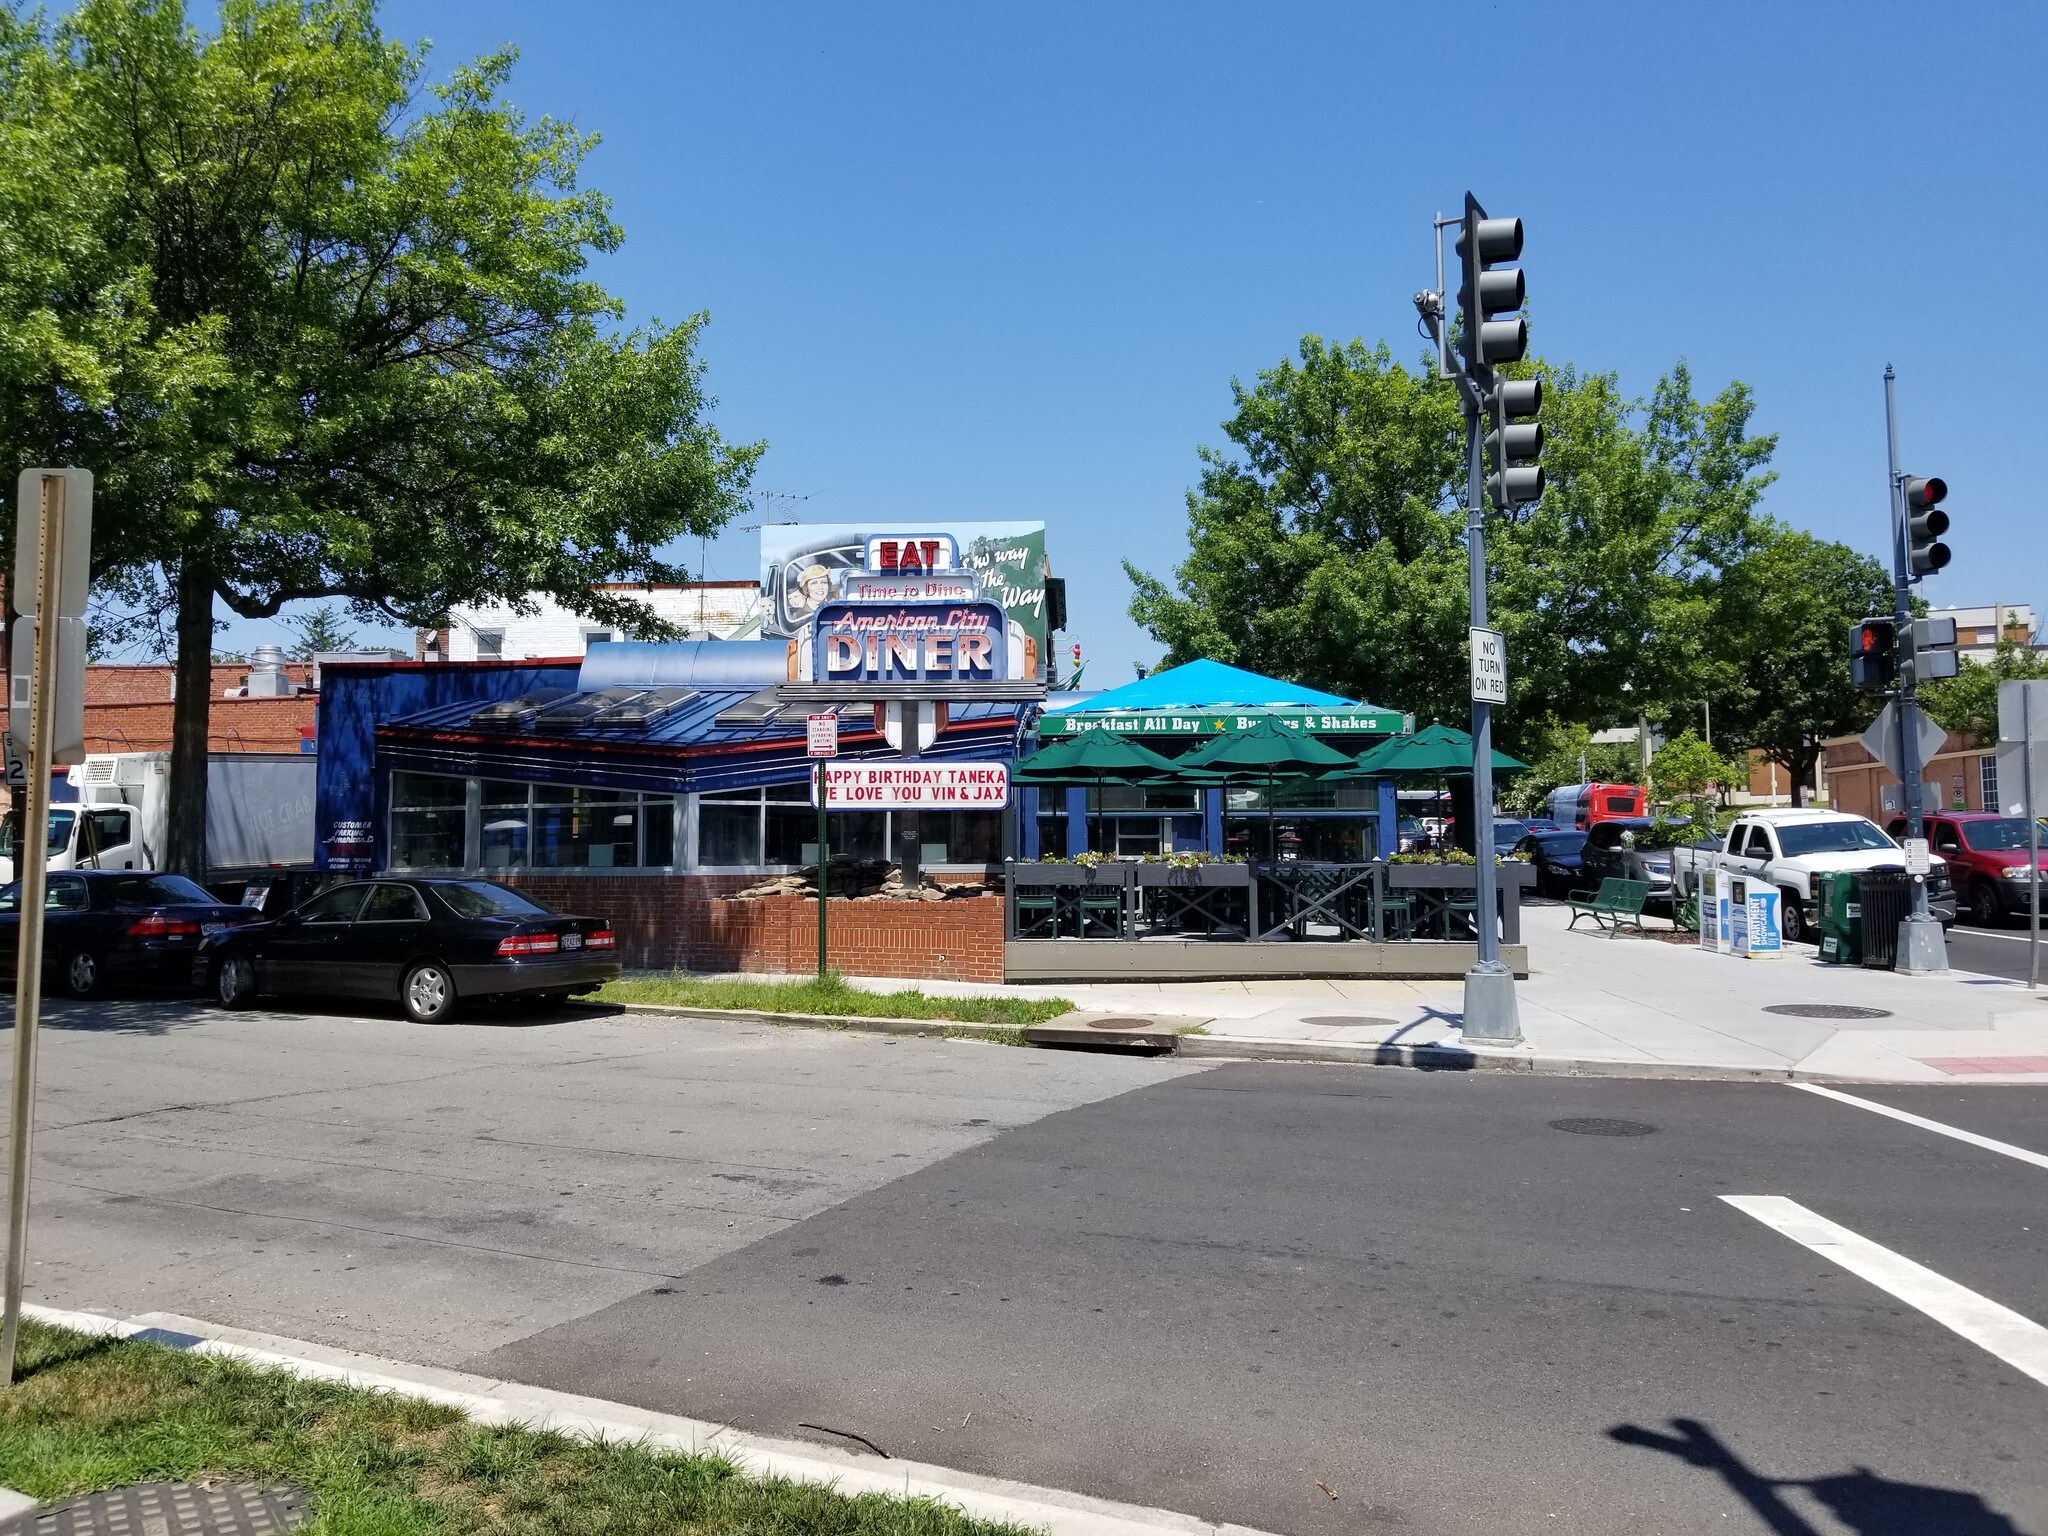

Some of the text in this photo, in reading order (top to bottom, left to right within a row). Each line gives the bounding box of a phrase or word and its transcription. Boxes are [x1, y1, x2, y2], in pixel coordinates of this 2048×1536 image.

[880, 541, 939, 569] EAT
[973, 552, 990, 570] no
[994, 547, 1029, 570] way
[981, 567, 1005, 589] the
[857, 583, 897, 598] Time
[925, 582, 964, 597] Dine
[1001, 585, 1045, 619] Way
[831, 608, 990, 633] American City
[827, 634, 993, 672] DINER
[1482, 640, 1496, 656] NO
[1478, 658, 1501, 675] TURN
[1475, 677, 1504, 694] ON RED
[1144, 717, 1166, 730] All
[1172, 717, 1200, 732] Day
[1236, 716, 1299, 730] Burs
[1304, 716, 1316, 730] &
[1321, 715, 1377, 730] Shakes
[9, 760, 24, 780] 2
[868, 770, 942, 784] BIRTHDAY
[948, 770, 1006, 784] TANEKA
[846, 786, 883, 801] LOVE
[892, 786, 922, 801] YOU
[932, 786, 956, 800] VIN
[960, 786, 969, 800] &
[973, 786, 1004, 800] JAX
[279, 795, 311, 824] CRAB
[333, 821, 372, 829] CUSTOMER
[334, 829, 365, 837] PARKING
[325, 835, 365, 843] American
[1749, 897, 1761, 946] APARTMENT
[1760, 909, 1768, 946] SHOWCASE
